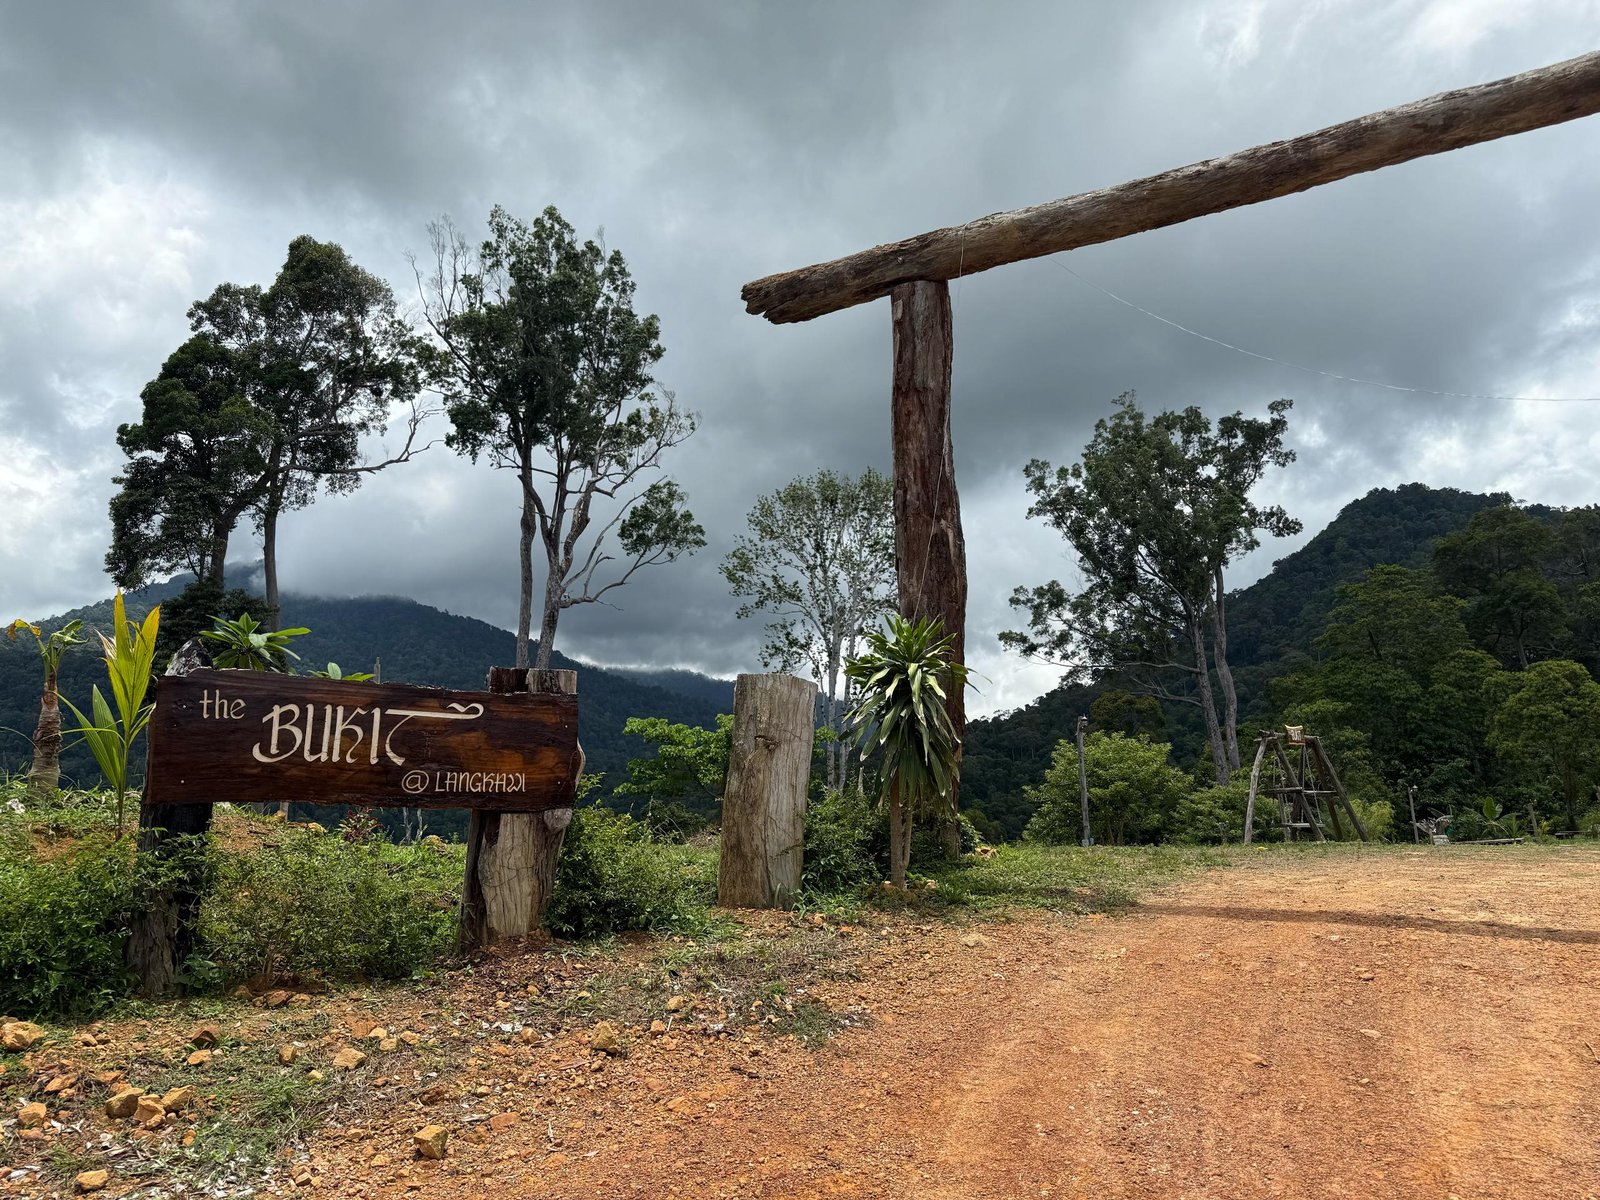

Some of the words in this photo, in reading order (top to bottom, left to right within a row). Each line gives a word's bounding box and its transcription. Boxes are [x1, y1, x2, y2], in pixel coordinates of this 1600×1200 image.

[199, 689, 247, 720] the
[252, 703, 485, 767] BUKIT
[401, 769, 430, 794] @
[434, 771, 527, 793] LANGKAWI
